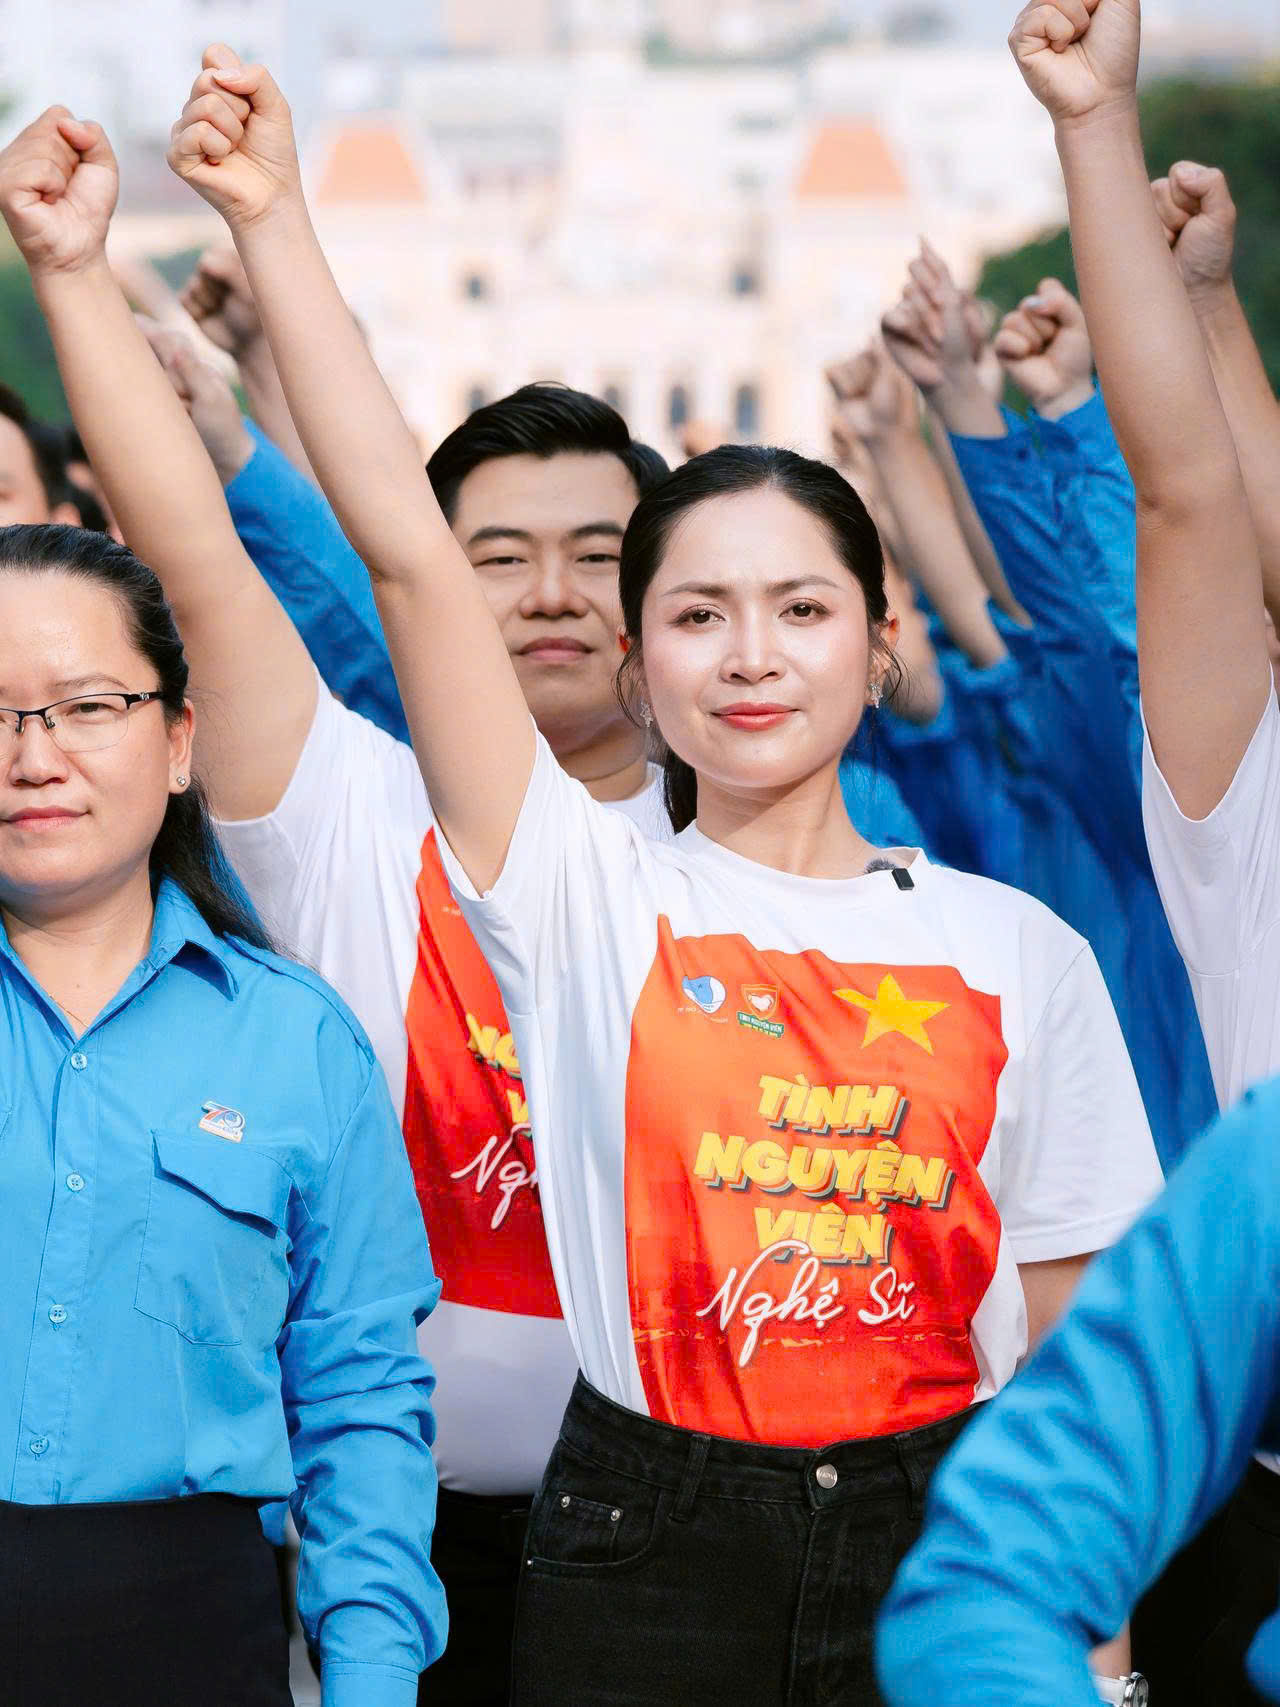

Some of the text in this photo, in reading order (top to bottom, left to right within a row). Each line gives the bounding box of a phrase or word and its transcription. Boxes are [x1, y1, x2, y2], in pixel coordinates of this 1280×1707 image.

[758, 1073, 907, 1136] TÌNH
[693, 1131, 954, 1212] NGUYỆN
[753, 1203, 894, 1266] VIÊN
[696, 1239, 916, 1367] Nghệ Sĩ
